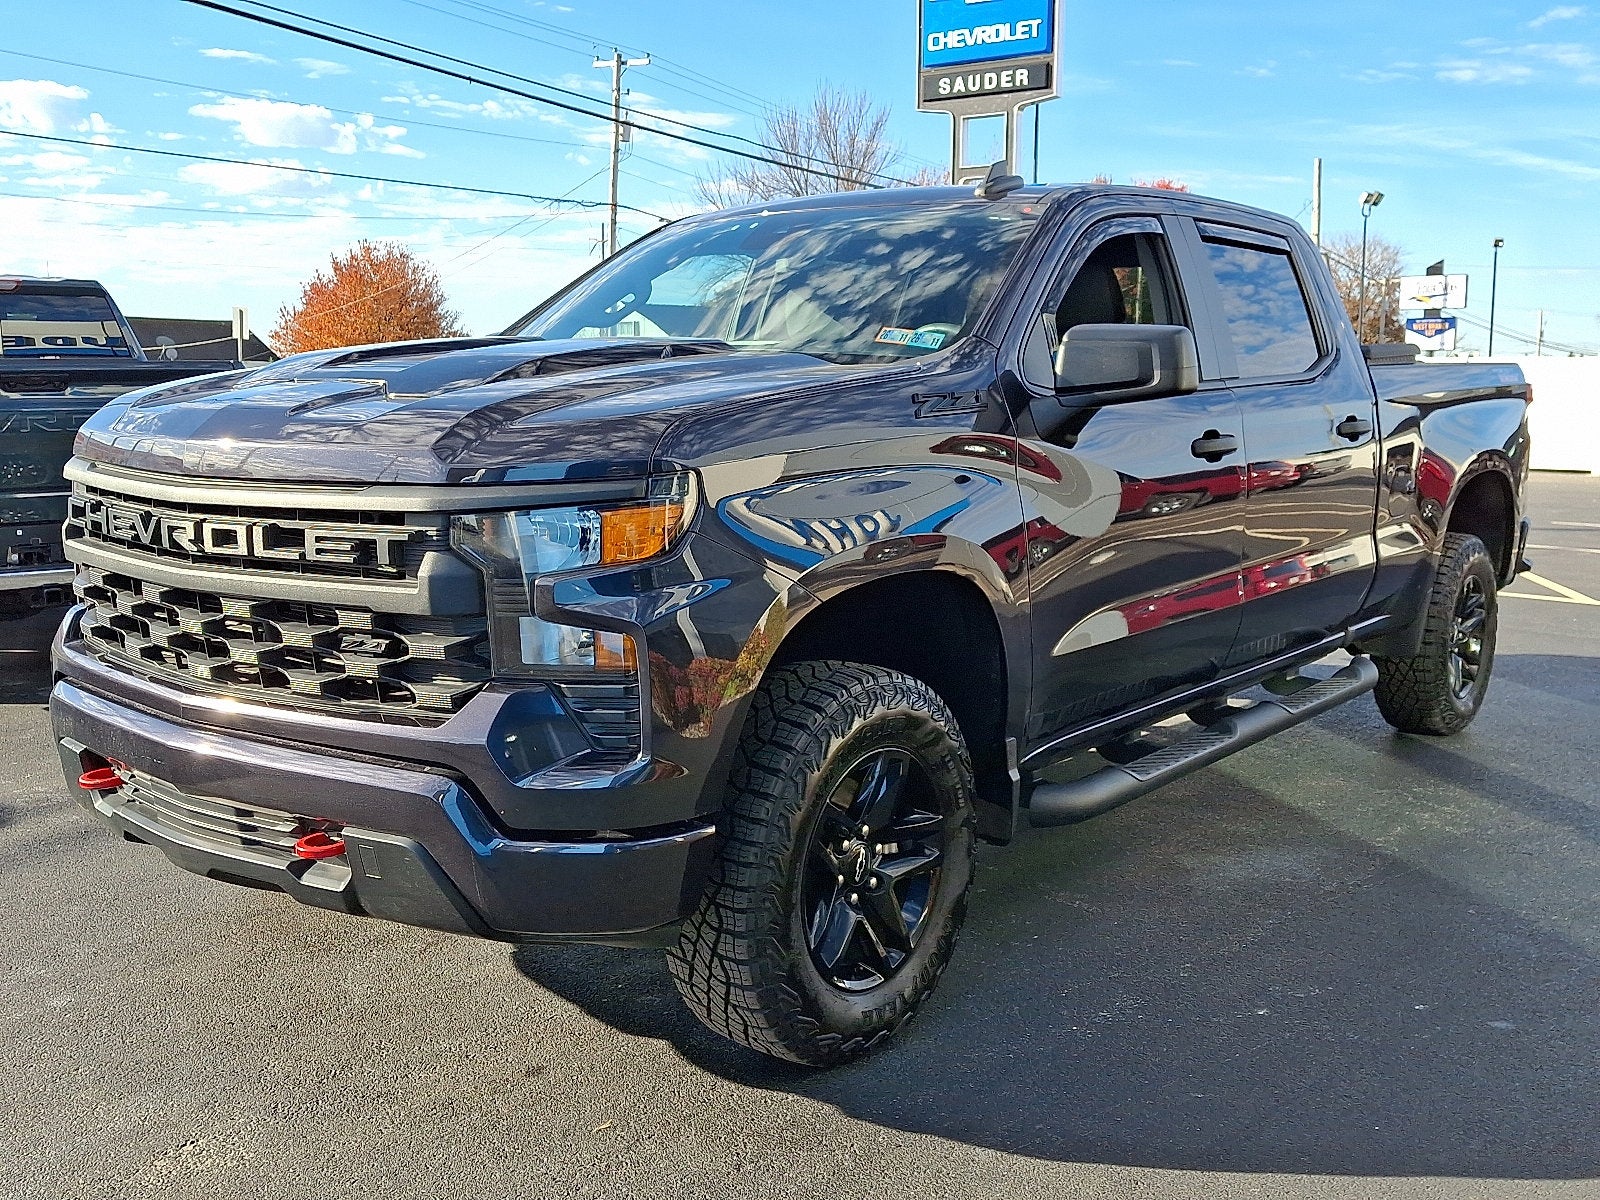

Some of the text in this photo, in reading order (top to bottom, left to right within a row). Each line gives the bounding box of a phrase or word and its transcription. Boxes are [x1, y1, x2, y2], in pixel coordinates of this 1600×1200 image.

[927, 19, 1042, 51] CHEVROLET
[938, 69, 1028, 95] SAUDER
[912, 389, 988, 419] Z71
[67, 497, 420, 566] CHEVROLET
